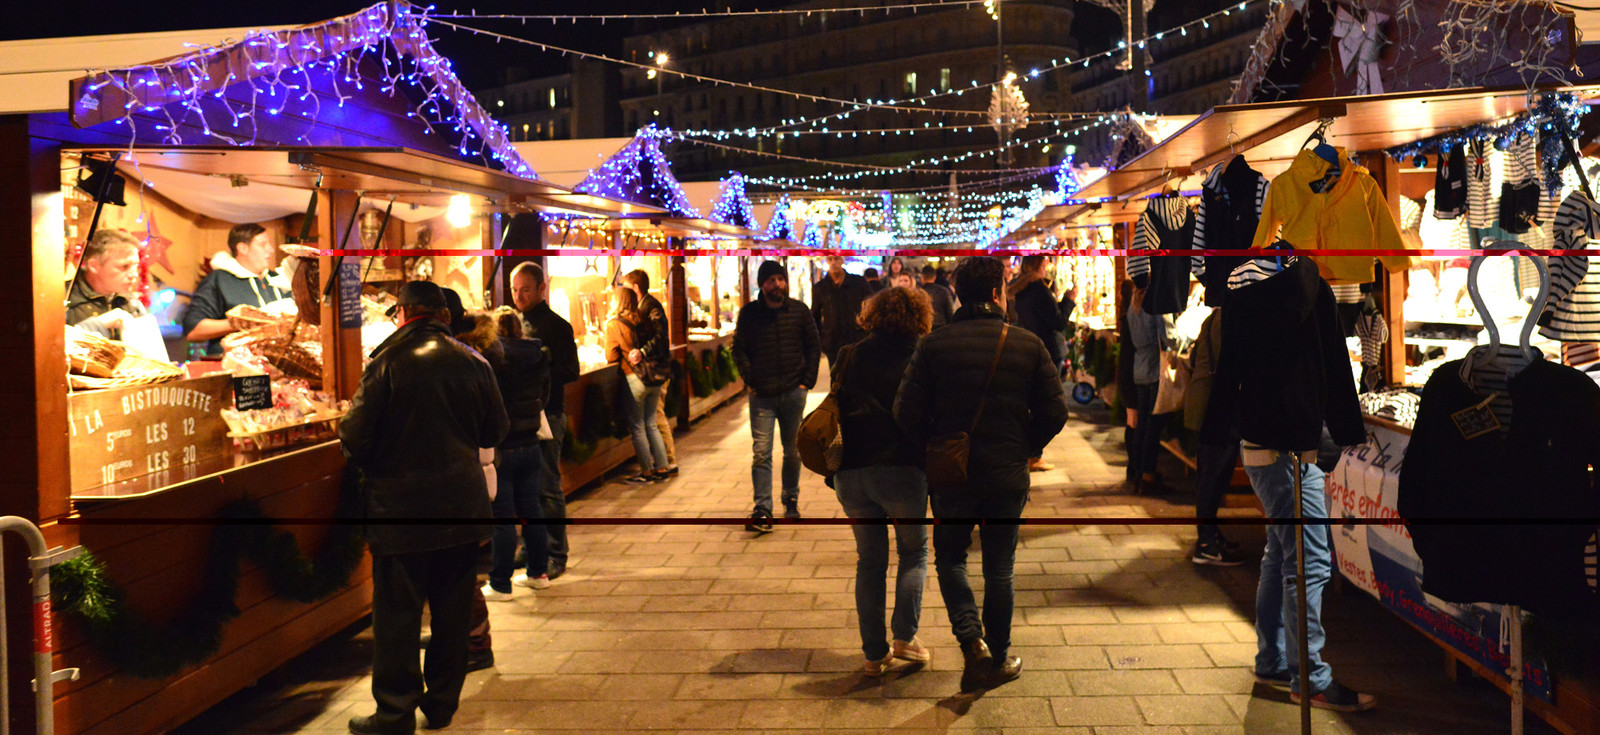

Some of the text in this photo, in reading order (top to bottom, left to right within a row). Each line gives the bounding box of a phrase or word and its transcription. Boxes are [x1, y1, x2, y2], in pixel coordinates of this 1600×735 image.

[85, 409, 103, 434] LA
[122, 386, 211, 415] BISTOUQUETTE
[146, 422, 168, 444] LES
[183, 417, 195, 436] 12
[147, 450, 169, 473] LES
[183, 445, 196, 464] 30
[42, 601, 52, 648] ALTRAD
